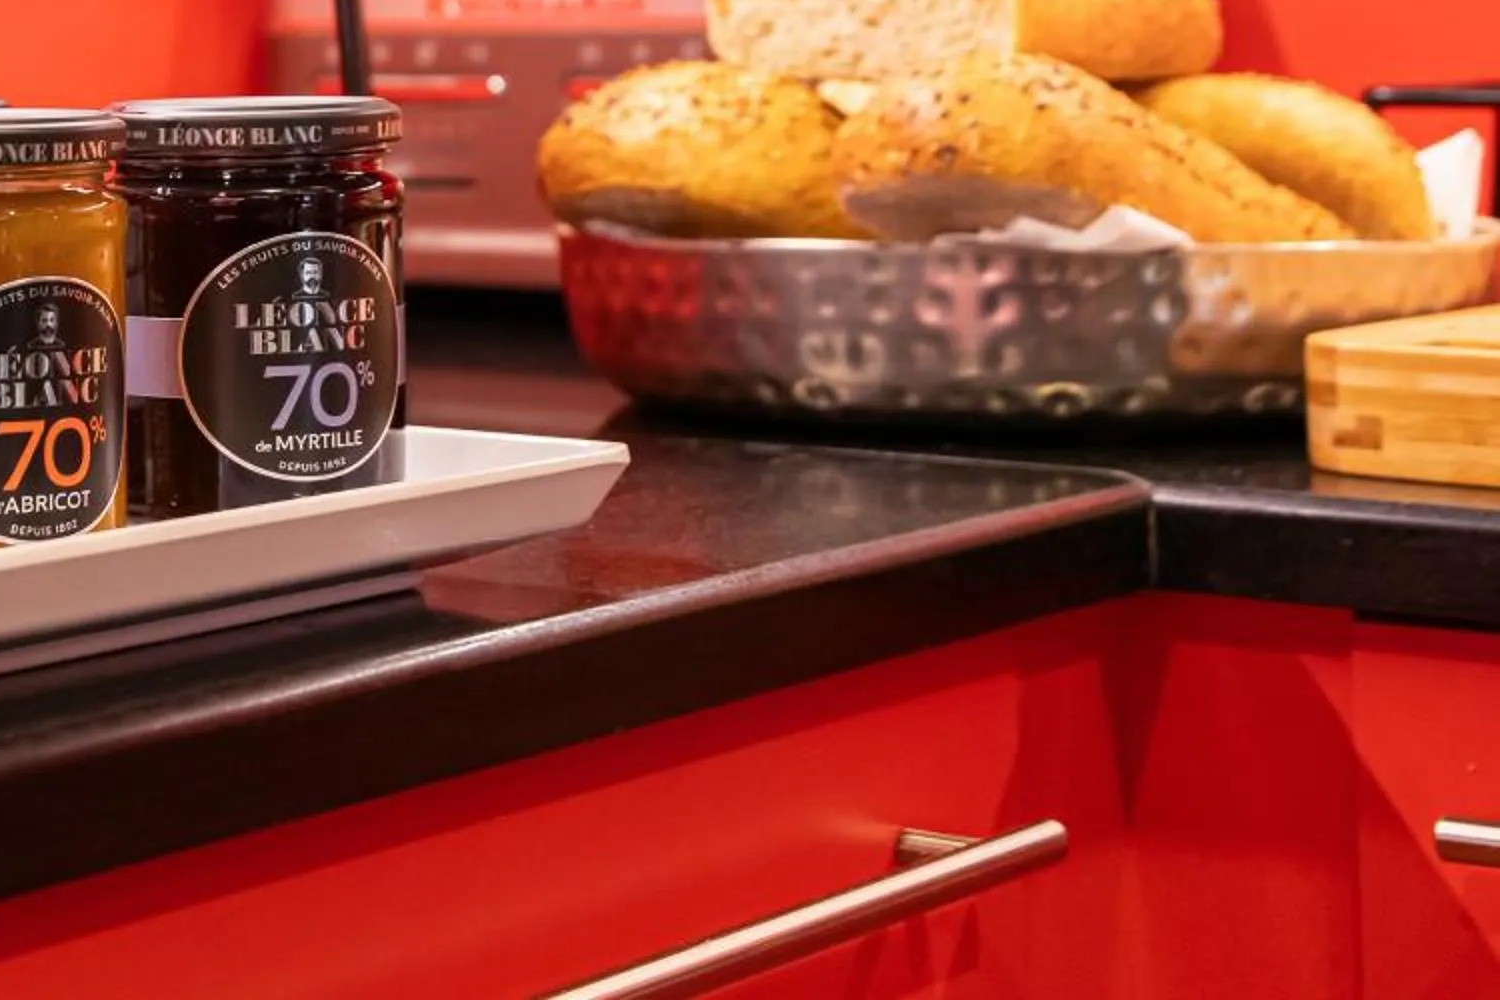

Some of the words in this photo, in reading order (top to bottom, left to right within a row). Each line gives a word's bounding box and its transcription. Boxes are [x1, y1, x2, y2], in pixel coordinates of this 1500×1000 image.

[156, 122, 245, 147] LÉONCE
[251, 124, 323, 147] BLANC
[53, 139, 107, 162] BLANC
[217, 267, 241, 290] LES
[241, 245, 292, 272] FRUITS
[292, 240, 313, 252] DU
[28, 285, 49, 298] DU
[234, 295, 375, 329] LÉONCE
[250, 325, 365, 355] BLANC
[255, 439, 273, 453] de
[275, 429, 364, 452] MYRTILLE
[279, 459, 321, 472] DEPUIS
[9, 522, 53, 537] DEPUIS
